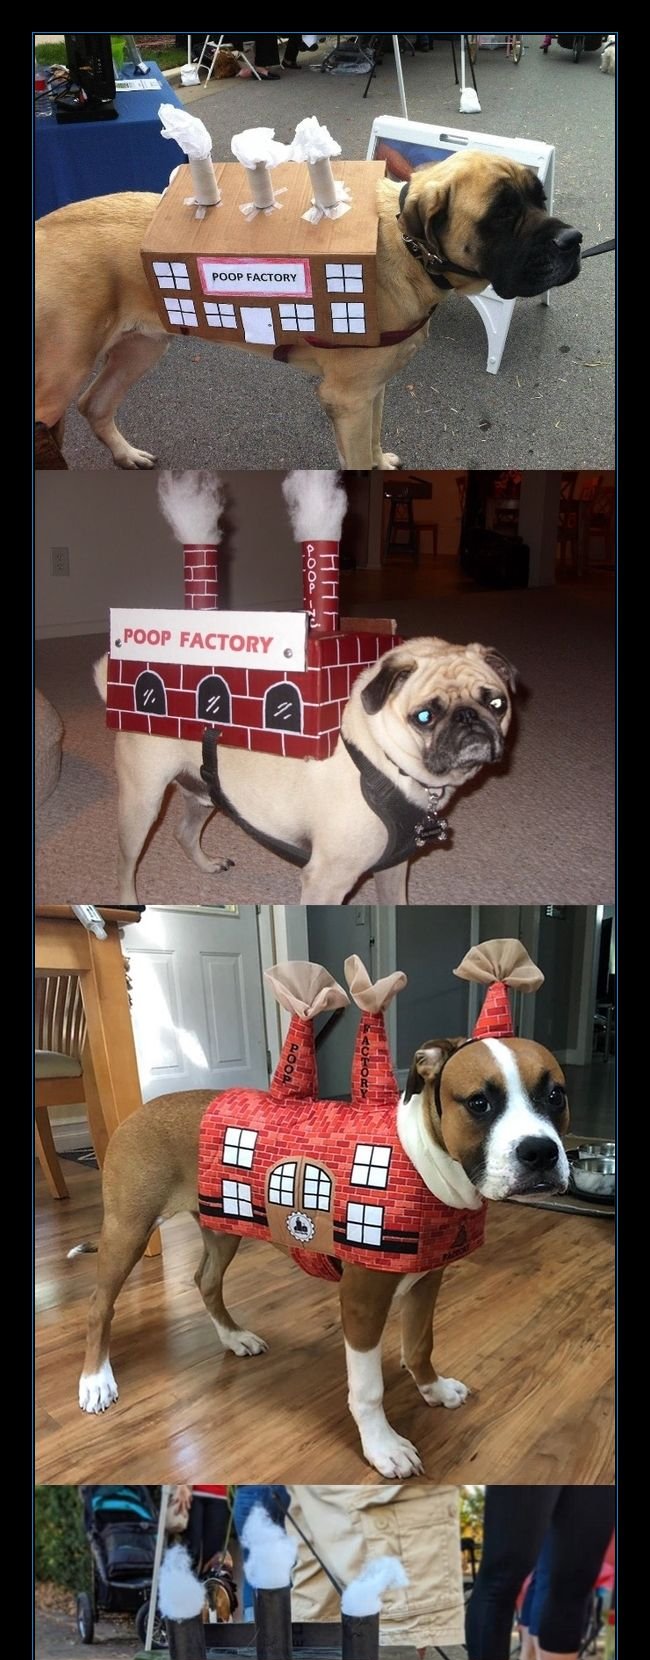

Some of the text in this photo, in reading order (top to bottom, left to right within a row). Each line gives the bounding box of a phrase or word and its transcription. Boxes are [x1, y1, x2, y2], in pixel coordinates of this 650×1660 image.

[212, 272, 297, 282] POOP FACTORY
[306, 544, 317, 595] POOP
[124, 628, 274, 654] POOP FACTORY
[282, 1044, 299, 1084] POOP
[360, 1024, 371, 1098] FACTORY
